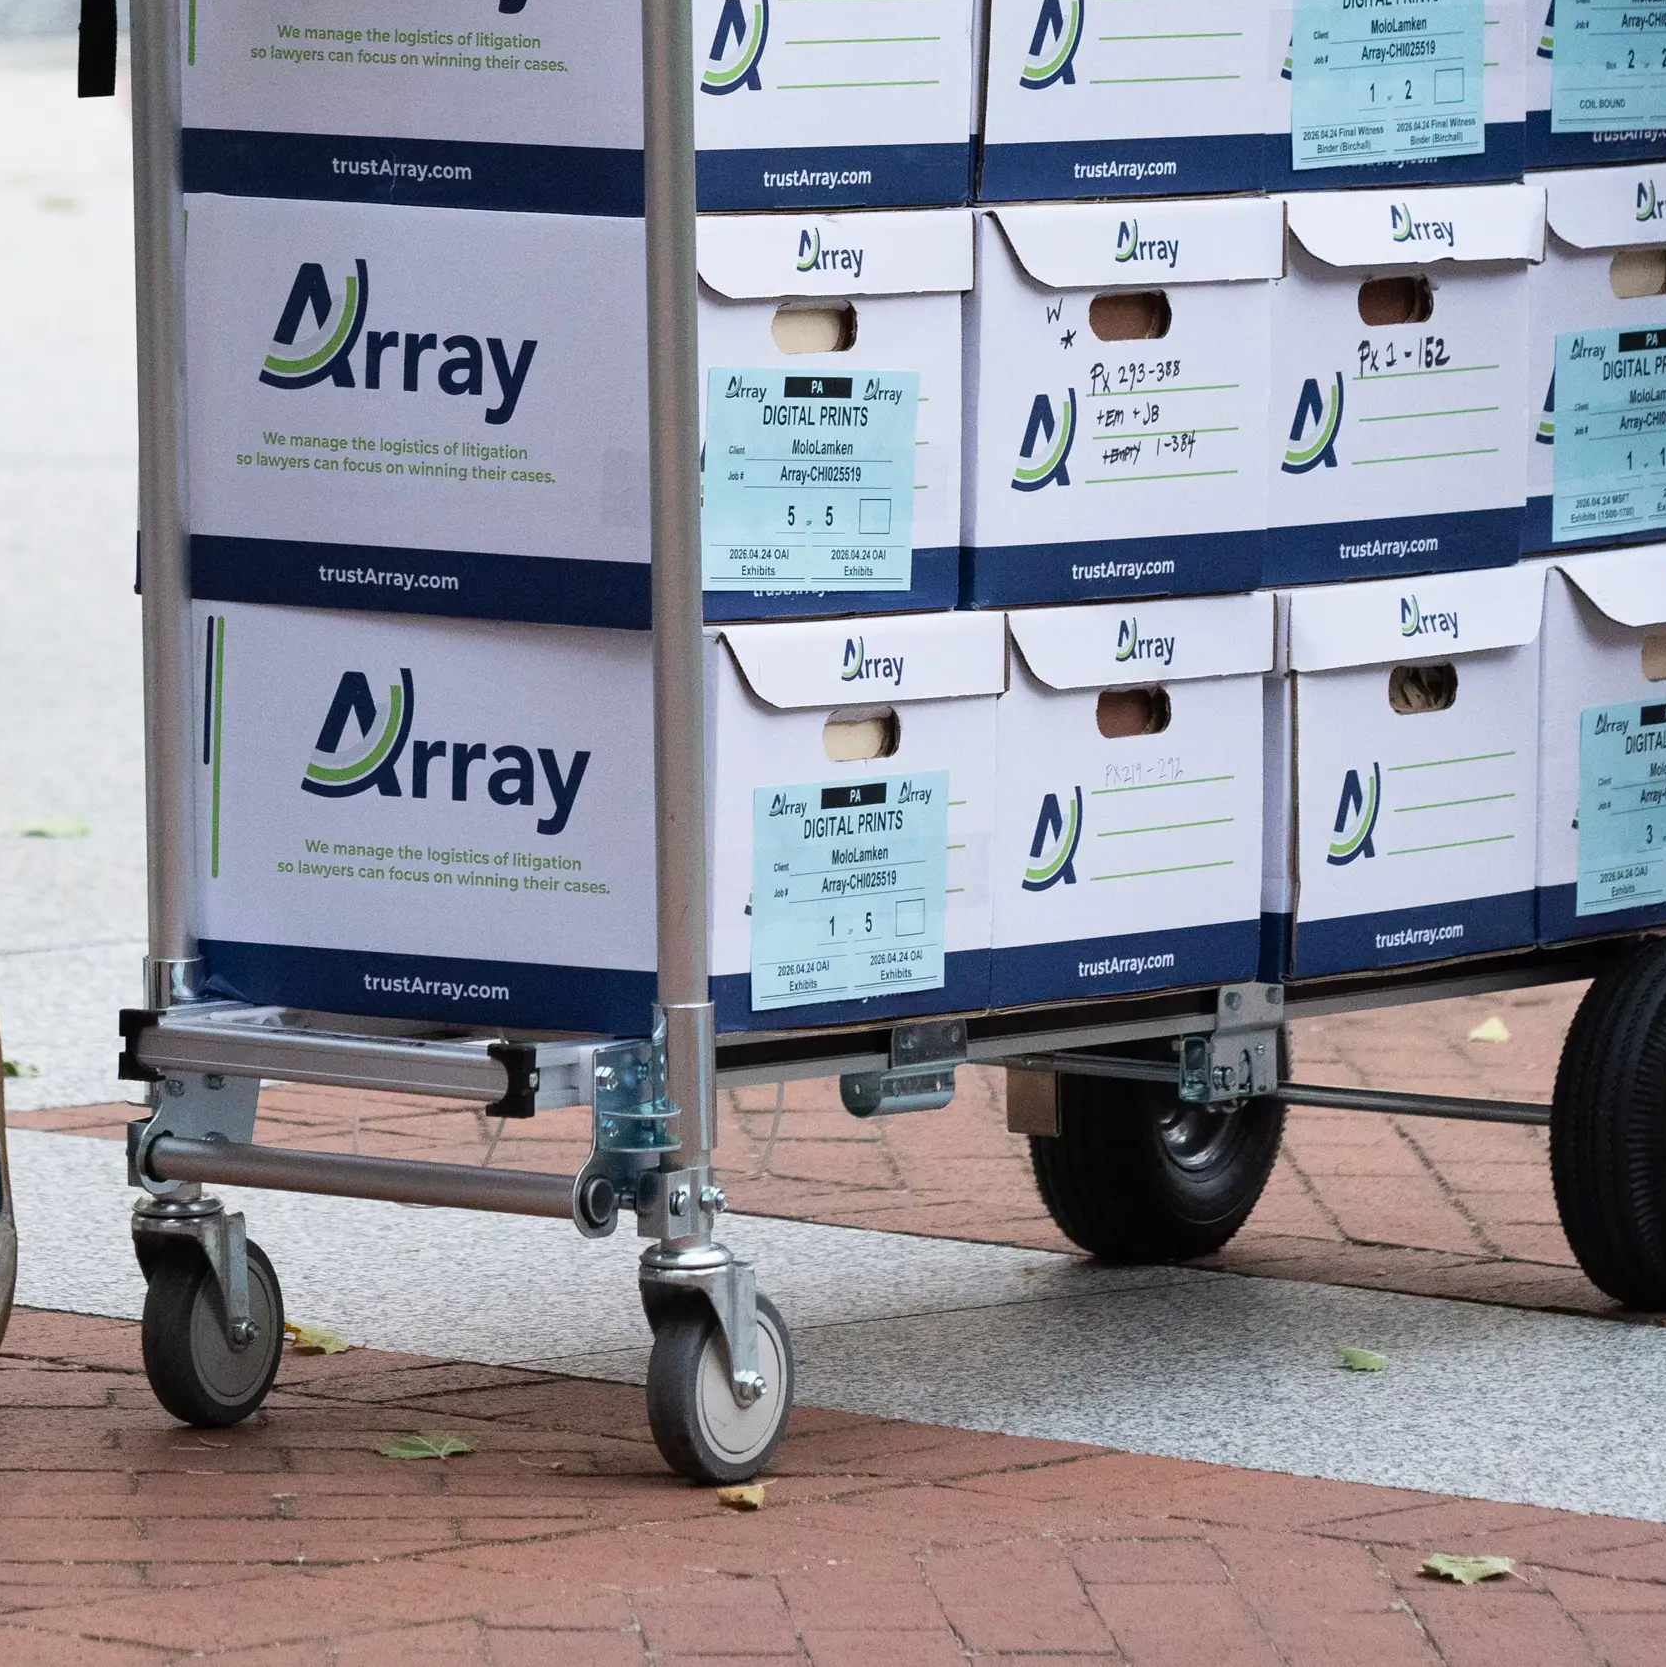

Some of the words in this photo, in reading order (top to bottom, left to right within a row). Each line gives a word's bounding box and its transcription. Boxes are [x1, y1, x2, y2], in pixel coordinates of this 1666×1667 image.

[277, 24, 300, 39] We
[305, 25, 362, 44] manage
[366, 27, 390, 42] the
[394, 29, 453, 48] logistics
[457, 32, 473, 46] of
[475, 32, 541, 50] litigation
[1371, 17, 1427, 33] MoloLamken
[250, 45, 267, 59] so
[270, 45, 324, 64] lawyers
[329, 49, 353, 63] can
[357, 48, 396, 65] focus
[400, 52, 419, 65] on
[423, 53, 482, 72] winning
[485, 55, 520, 71] their
[524, 58, 568, 72] cases.
[1361, 40, 1436, 62] Array-CHI025519
[1628, 49, 1635, 69] 2
[1370, 83, 1375, 103] 1
[1405, 80, 1412, 100] 2
[1599, 99, 1625, 108] BOUND
[1339, 128, 1357, 138] Final
[1358, 125, 1384, 135] Witness
[1317, 144, 1340, 154] Binder
[332, 157, 472, 182] trustArray.com
[763, 169, 871, 189] trustArray.com
[1074, 158, 1177, 179] trustArray.com
[1390, 202, 1453, 247] Array
[797, 227, 863, 278] Array
[1115, 219, 1178, 268] Array
[1046, 297, 1063, 324] W
[258, 259, 538, 425] Array
[1646, 333, 1658, 346] PA
[1603, 360, 1651, 381] DIGITAL
[725, 375, 767, 403] Array
[811, 380, 823, 394] PA
[863, 378, 902, 405] Array
[763, 405, 815, 426] DIGITAL
[820, 406, 868, 426] PRINTS
[263, 432, 286, 447] We
[290, 433, 348, 453] manage
[351, 436, 375, 451] the
[380, 437, 439, 457] logistics
[443, 440, 459, 454] of
[462, 441, 528, 461] litigation
[728, 445, 745, 455] Client
[792, 439, 853, 455] MoloLamken
[236, 452, 253, 466] so
[256, 452, 310, 471] lawyers
[314, 456, 339, 471] can
[343, 456, 382, 474] focus
[386, 461, 404, 474] on
[408, 462, 467, 481] winning
[472, 465, 507, 481] their
[511, 468, 556, 484] cases.
[728, 472, 739, 481] Job
[780, 466, 861, 485] Array-CHI025519
[788, 505, 795, 526] 5
[826, 505, 833, 526] 5
[729, 549, 772, 560] 2026.04.24
[774, 549, 789, 559] OAI
[831, 549, 871, 560] 2026.04.24
[872, 550, 886, 560] OAI
[1339, 538, 1438, 559] trustArray.com
[318, 564, 459, 591] trustArray.com
[741, 565, 776, 576] Exhibits
[844, 566, 873, 577] Exhibits
[1072, 558, 1174, 580] trustArray.com
[1401, 594, 1458, 639] Array
[1116, 617, 1175, 665] Array
[841, 636, 904, 686] Array
[300, 667, 591, 835] Array
[850, 789, 861, 803] PA
[804, 816, 854, 839] DIGITAL
[858, 809, 903, 833] PRINTS
[305, 838, 329, 854] We
[334, 841, 394, 860] manage
[398, 844, 423, 860] the
[427, 847, 489, 867] logistics
[494, 851, 510, 865] of
[513, 852, 582, 872] litigation
[832, 846, 888, 865] MoloLamken
[277, 860, 294, 873] so
[298, 859, 354, 878] lawyers
[358, 865, 385, 879] can
[389, 866, 429, 883] focus
[434, 871, 453, 884] on
[457, 872, 519, 892] winning
[523, 876, 560, 892] their
[564, 880, 610, 895] cases.
[821, 870, 896, 894] Array-CHI025519
[829, 915, 835, 937] 1
[865, 912, 872, 932] 5
[1376, 922, 1464, 949] trustArray.com
[1078, 952, 1174, 978] trustArray.com
[364, 973, 510, 1000] trustArray.com
